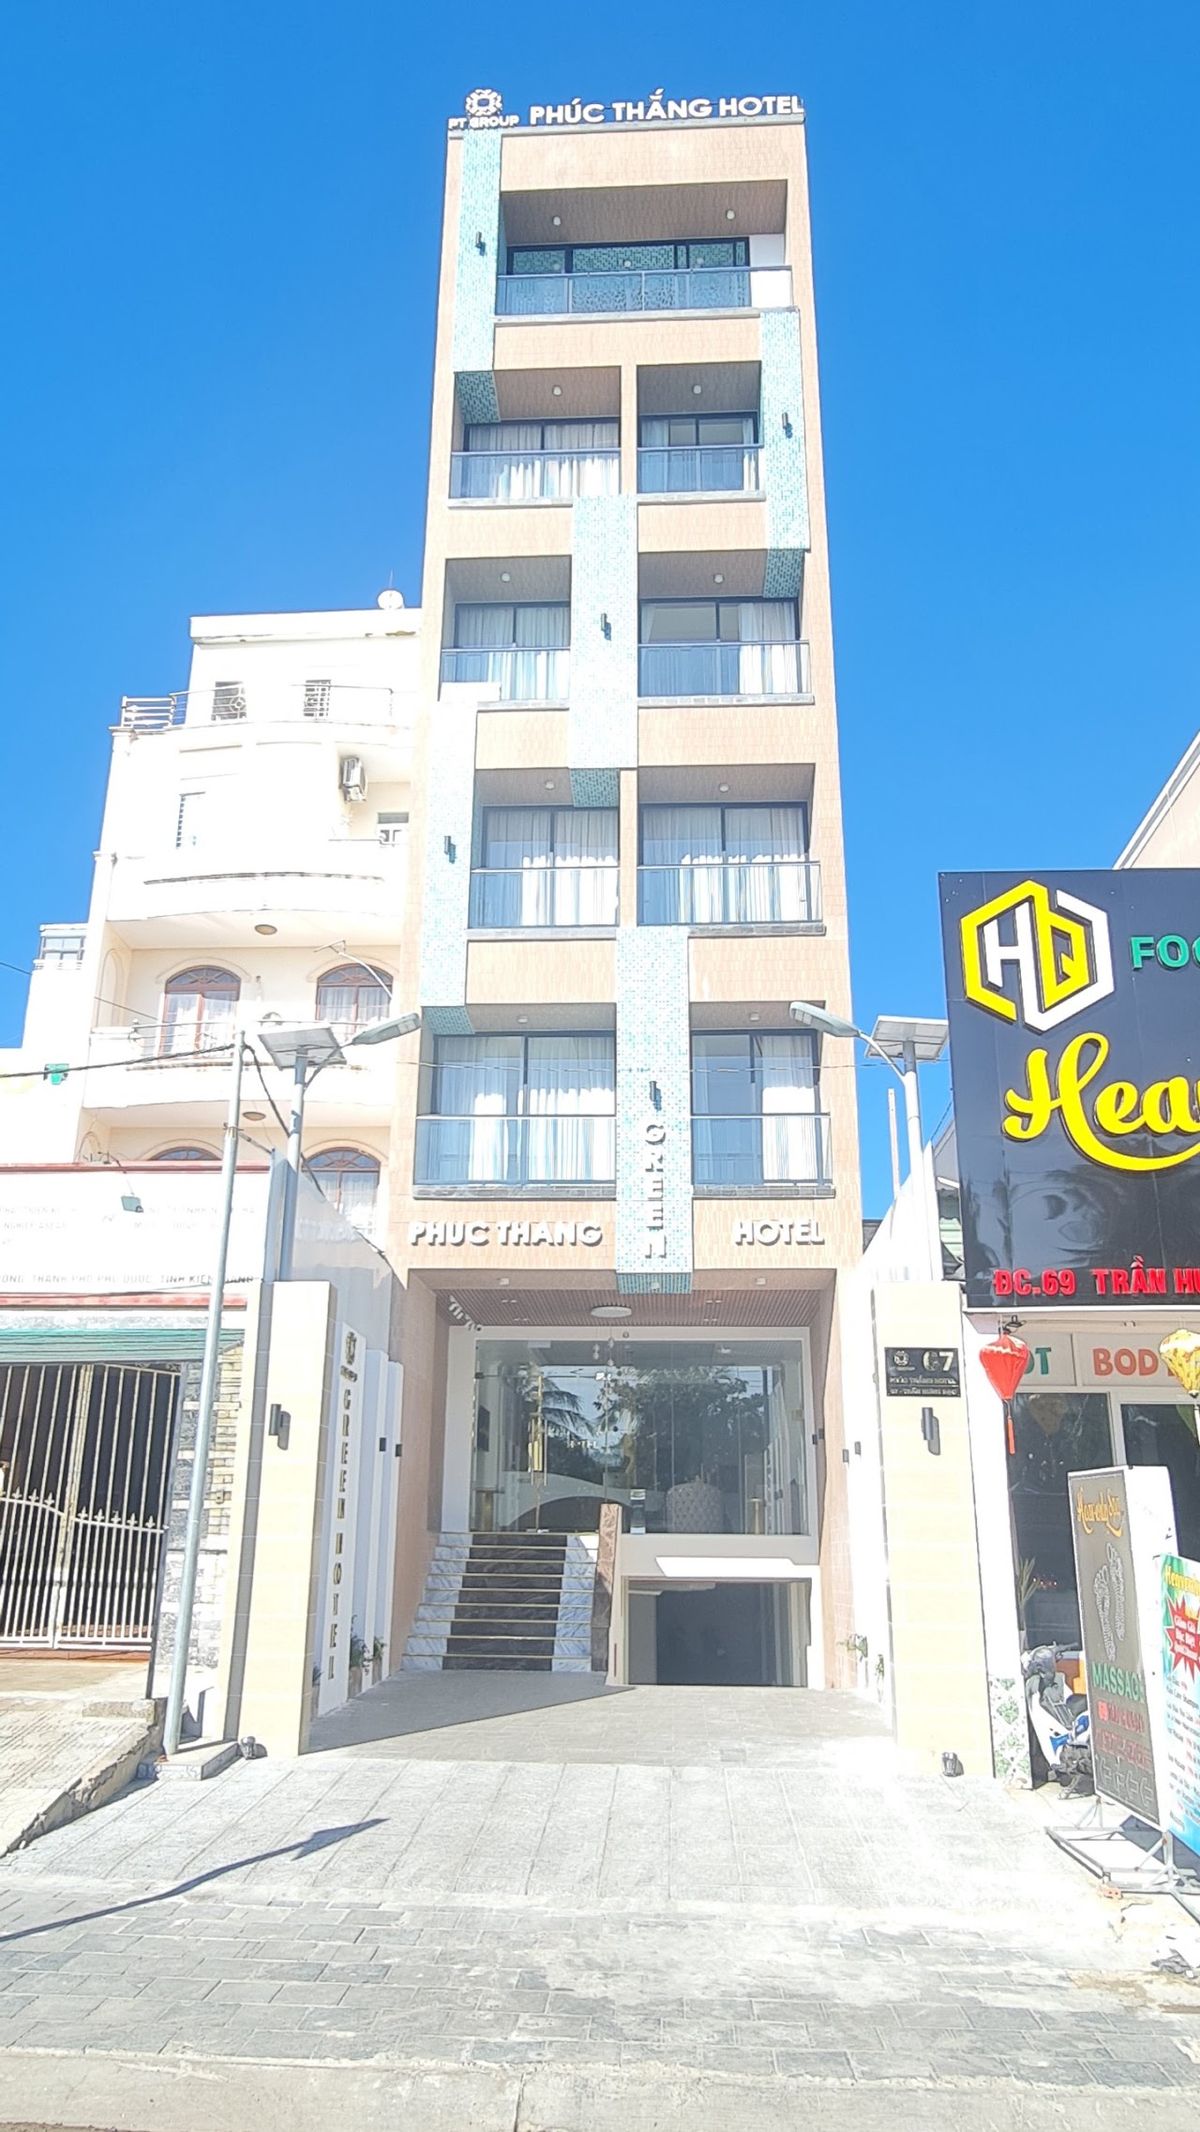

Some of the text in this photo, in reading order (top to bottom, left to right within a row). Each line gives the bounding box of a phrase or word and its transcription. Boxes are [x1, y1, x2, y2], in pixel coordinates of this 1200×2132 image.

[448, 114, 520, 129] PT GROUP
[529, 88, 804, 125] PHÚC THẮNG HOTEL
[1003, 1032, 1200, 1171] Hea
[643, 1122, 667, 1259] GREEN
[409, 1220, 603, 1247] PHUC THANG
[734, 1219, 825, 1246] HOTEL
[1091, 1254, 1168, 1296] TRẦN
[1093, 1348, 1177, 1376] BOD
